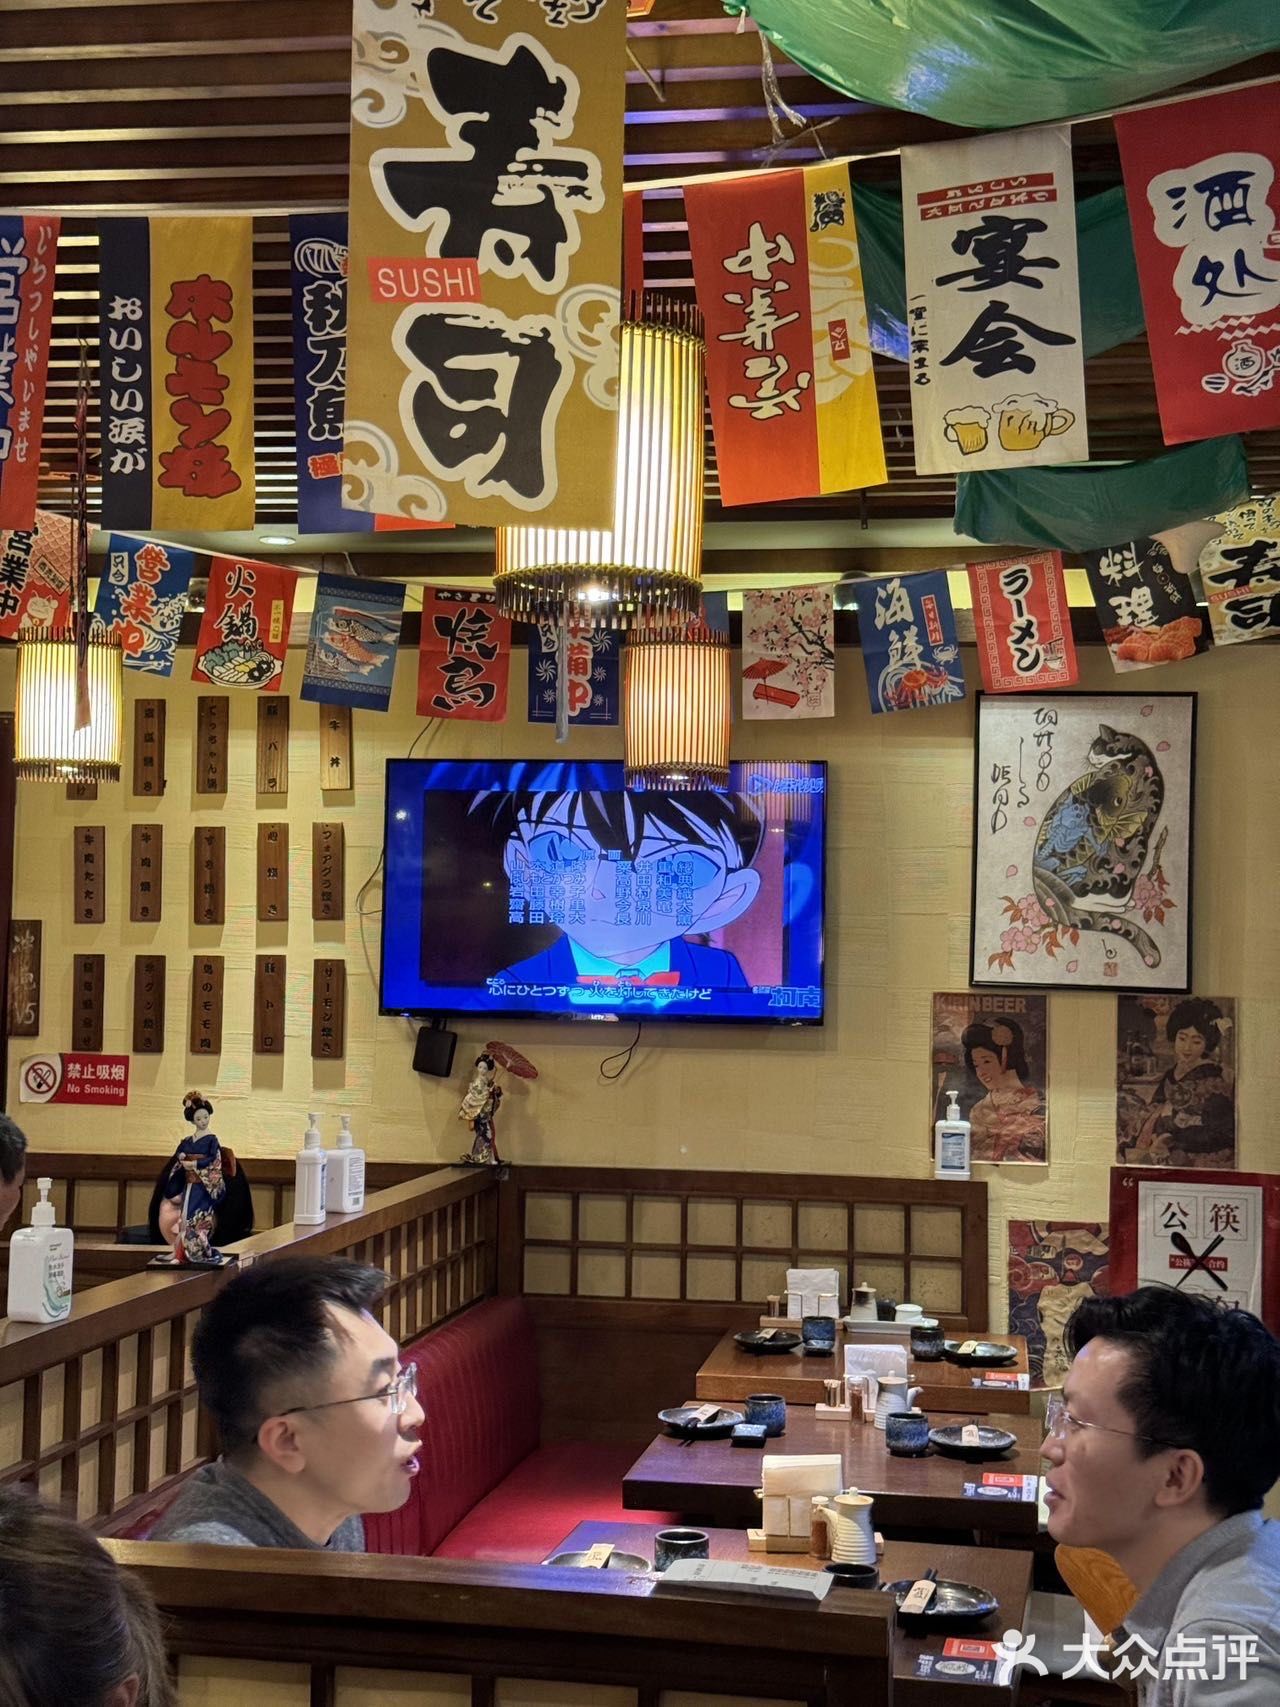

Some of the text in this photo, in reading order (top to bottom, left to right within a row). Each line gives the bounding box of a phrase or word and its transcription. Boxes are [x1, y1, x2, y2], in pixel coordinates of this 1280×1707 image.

[378, 267, 476, 299] SUSHI
[936, 215, 1076, 378] 宴会
[1099, 541, 1159, 628] 料理
[1209, 588, 1251, 602] SUSHI
[1002, 566, 1040, 675] ラーメン
[67, 1063, 125, 1081] 禁止吸烟
[67, 1083, 125, 1097] No Smoking
[1160, 1201, 1240, 1233] 公筷
